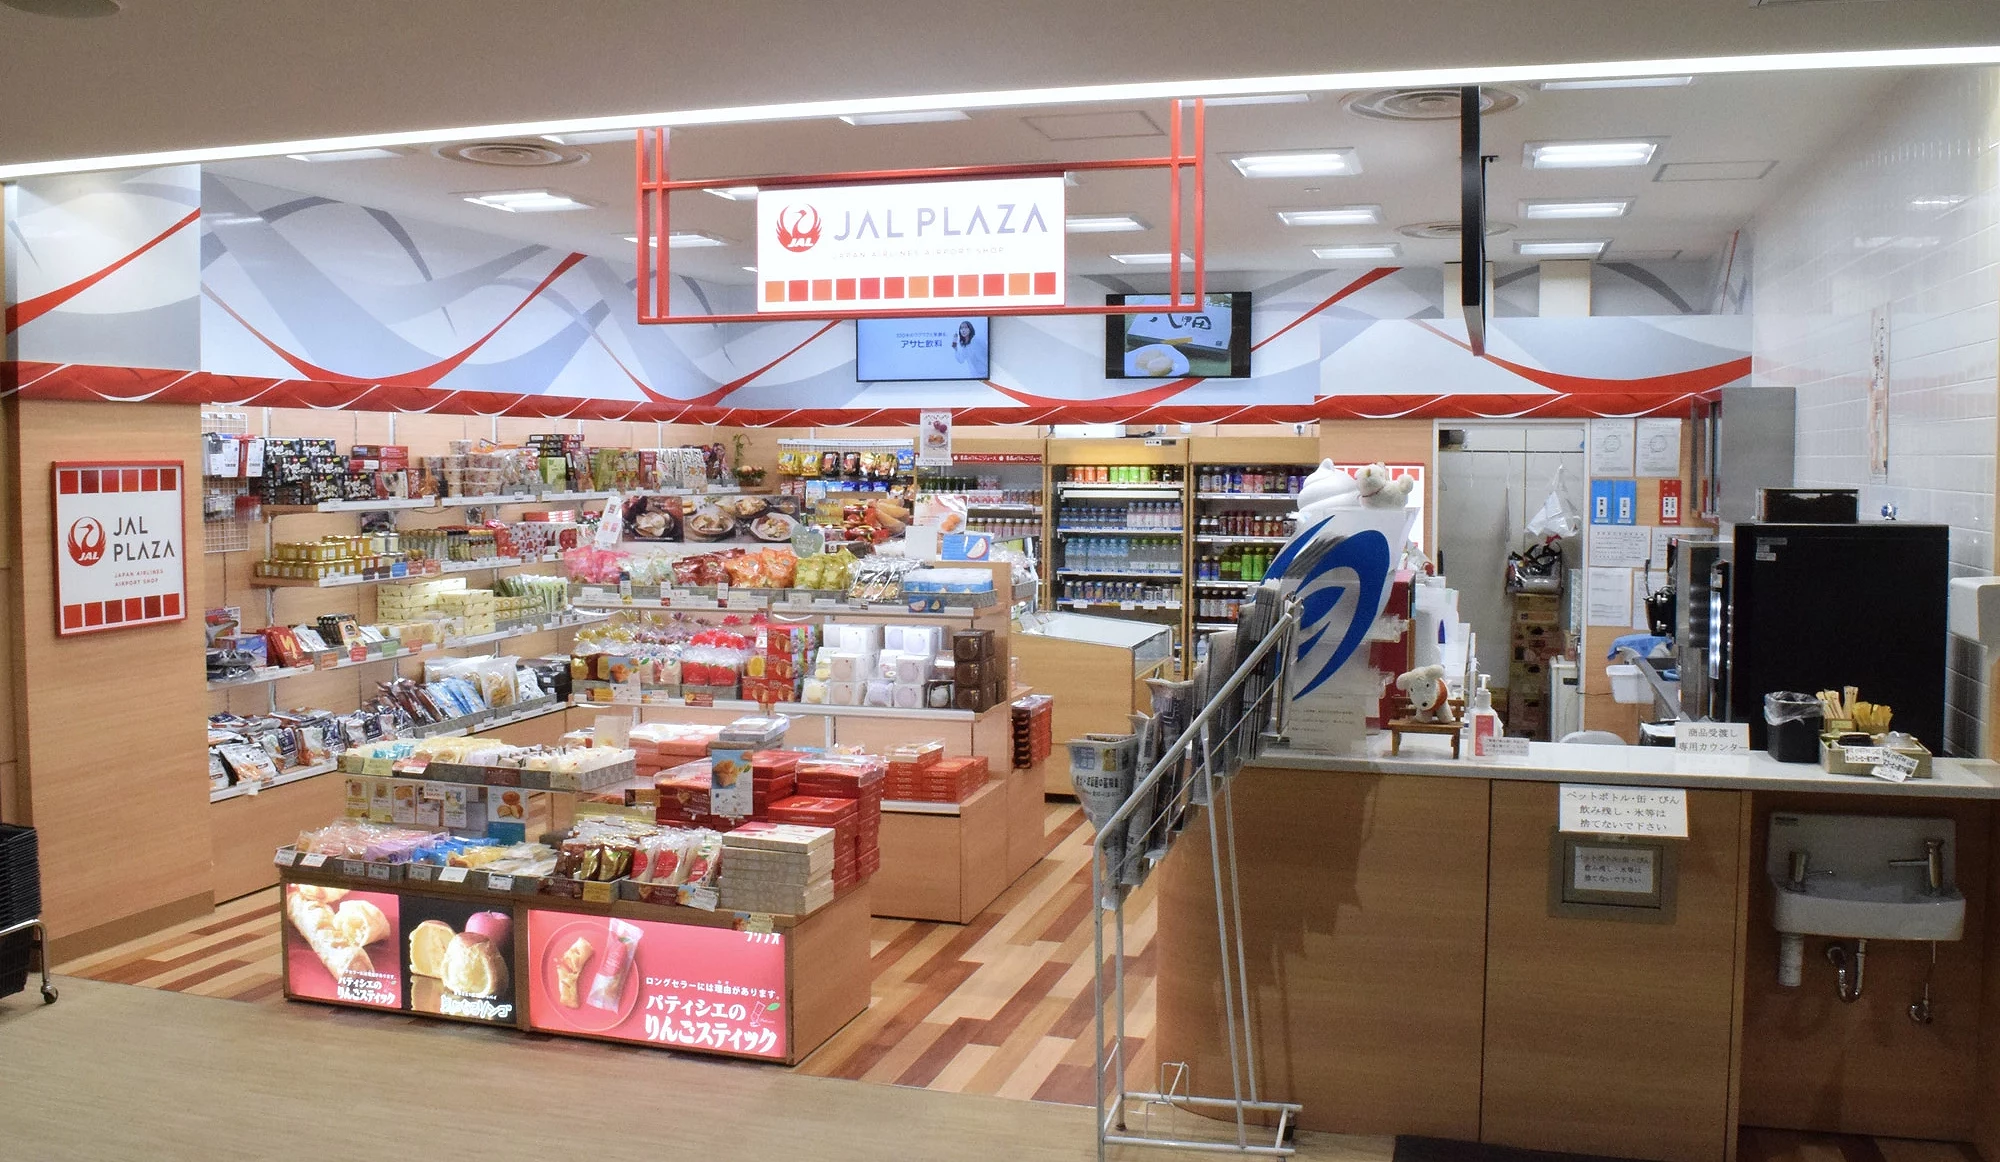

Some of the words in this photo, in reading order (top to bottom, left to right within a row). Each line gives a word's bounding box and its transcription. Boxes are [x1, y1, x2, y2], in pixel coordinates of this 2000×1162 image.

[834, 208, 904, 241] JAL
[917, 203, 1048, 238] PLAZA
[787, 237, 814, 248] JAL
[832, 251, 865, 260] JAPAN
[924, 247, 972, 256] AIRPORT
[976, 246, 1004, 254] SHOP
[901, 339, 943, 349] アサヒ飲料
[113, 516, 148, 537] JAL
[78, 551, 100, 561] JAL
[113, 540, 175, 562] PLAZA
[114, 571, 134, 579] JAPAN
[136, 568, 164, 577] AIRLINES
[114, 580, 141, 588] AIRPORT
[143, 577, 159, 585] SHOP
[1688, 727, 1738, 738] 商品受渡し
[1679, 742, 1749, 752] 専用カウンター
[1579, 818, 1667, 831] 捨てないで下さい
[337, 976, 382, 990] パティシエの
[645, 977, 780, 1000] ロングセラーには理由があります。
[337, 986, 396, 1005] りんごスティック
[646, 994, 746, 1021] パティシエの
[645, 1014, 778, 1053] りんごスティック
